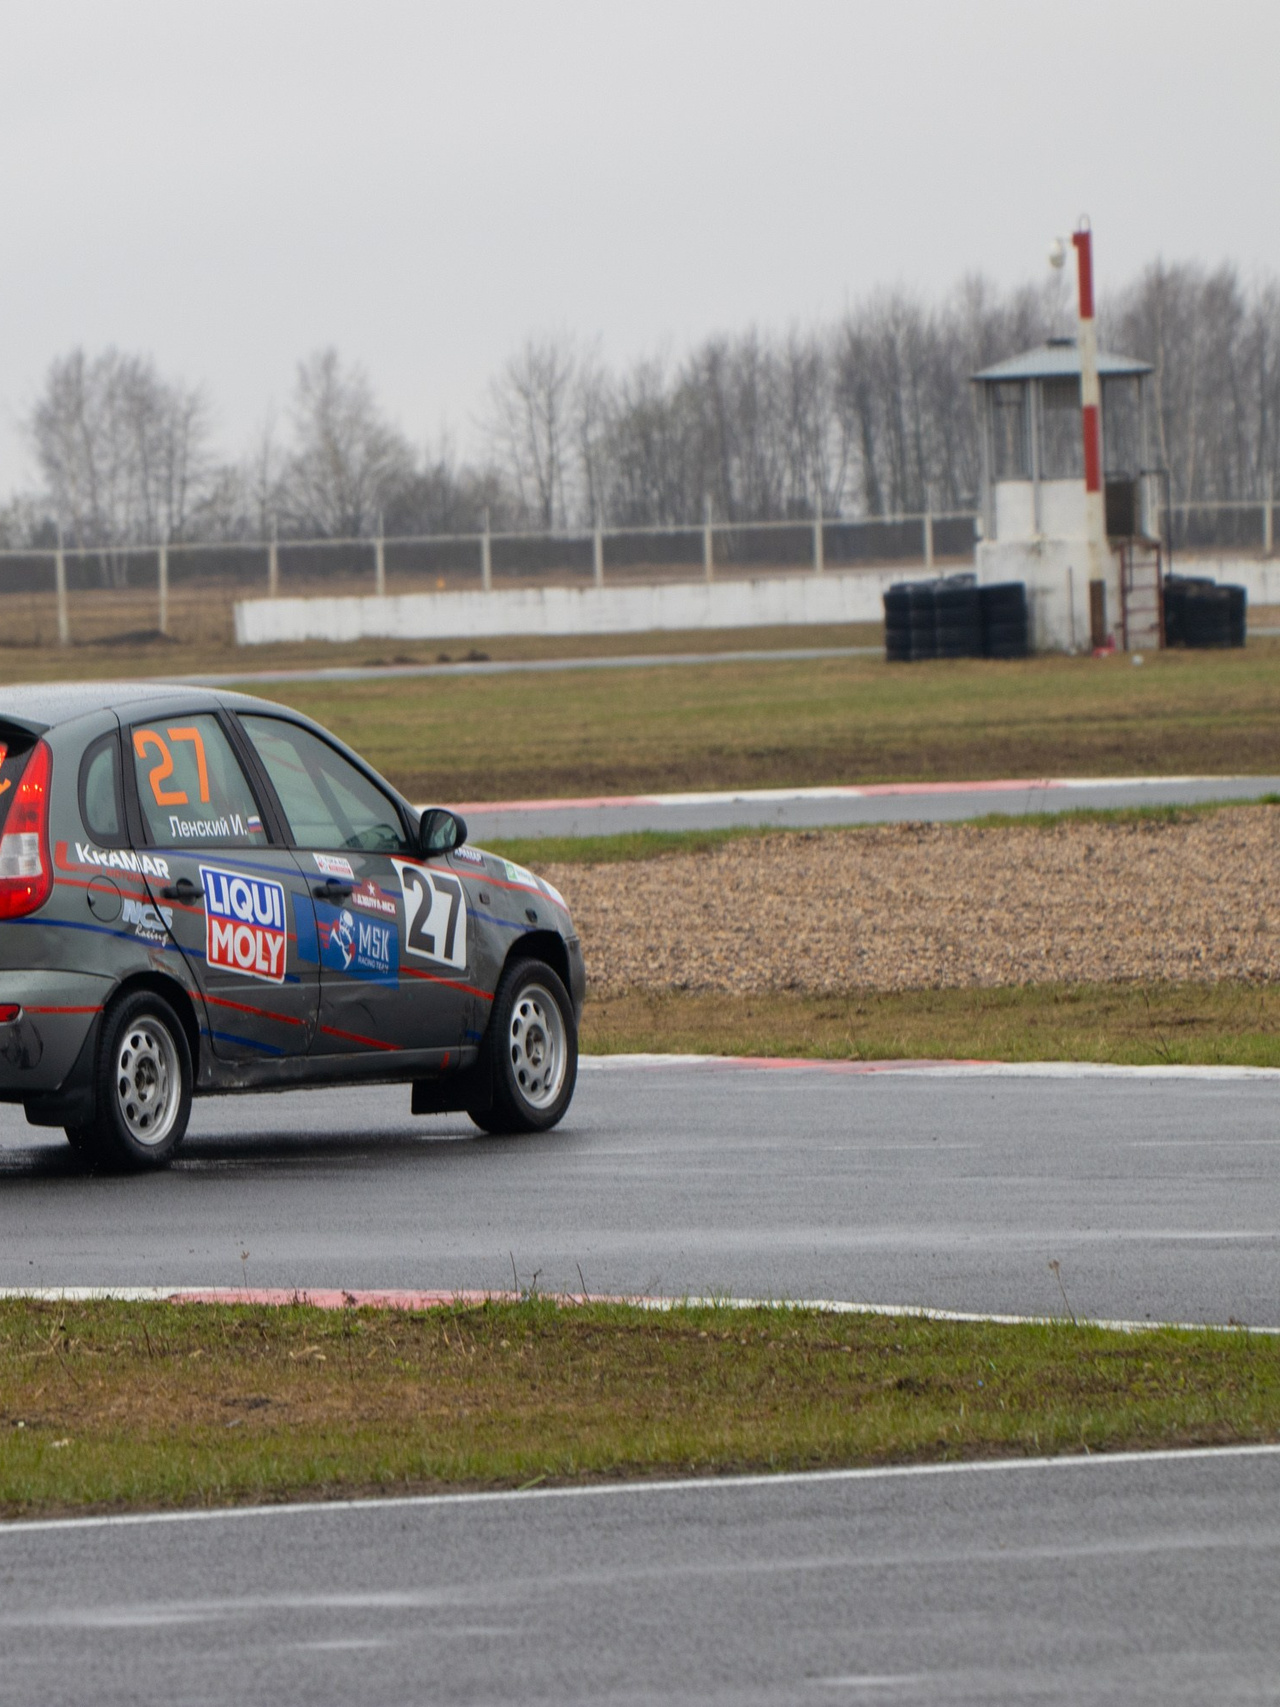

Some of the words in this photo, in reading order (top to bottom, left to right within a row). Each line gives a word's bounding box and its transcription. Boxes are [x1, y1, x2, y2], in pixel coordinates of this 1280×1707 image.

[132, 727, 210, 806] 27
[169, 815, 230, 838] Ленский
[230, 813, 248, 837] И.
[75, 842, 171, 879] KRAMAR
[122, 898, 174, 931] NCS
[206, 873, 281, 928] LIQUI
[402, 867, 462, 961] 27
[135, 924, 169, 947] Racing
[212, 919, 284, 974] MOLY
[359, 922, 390, 962] MSK
